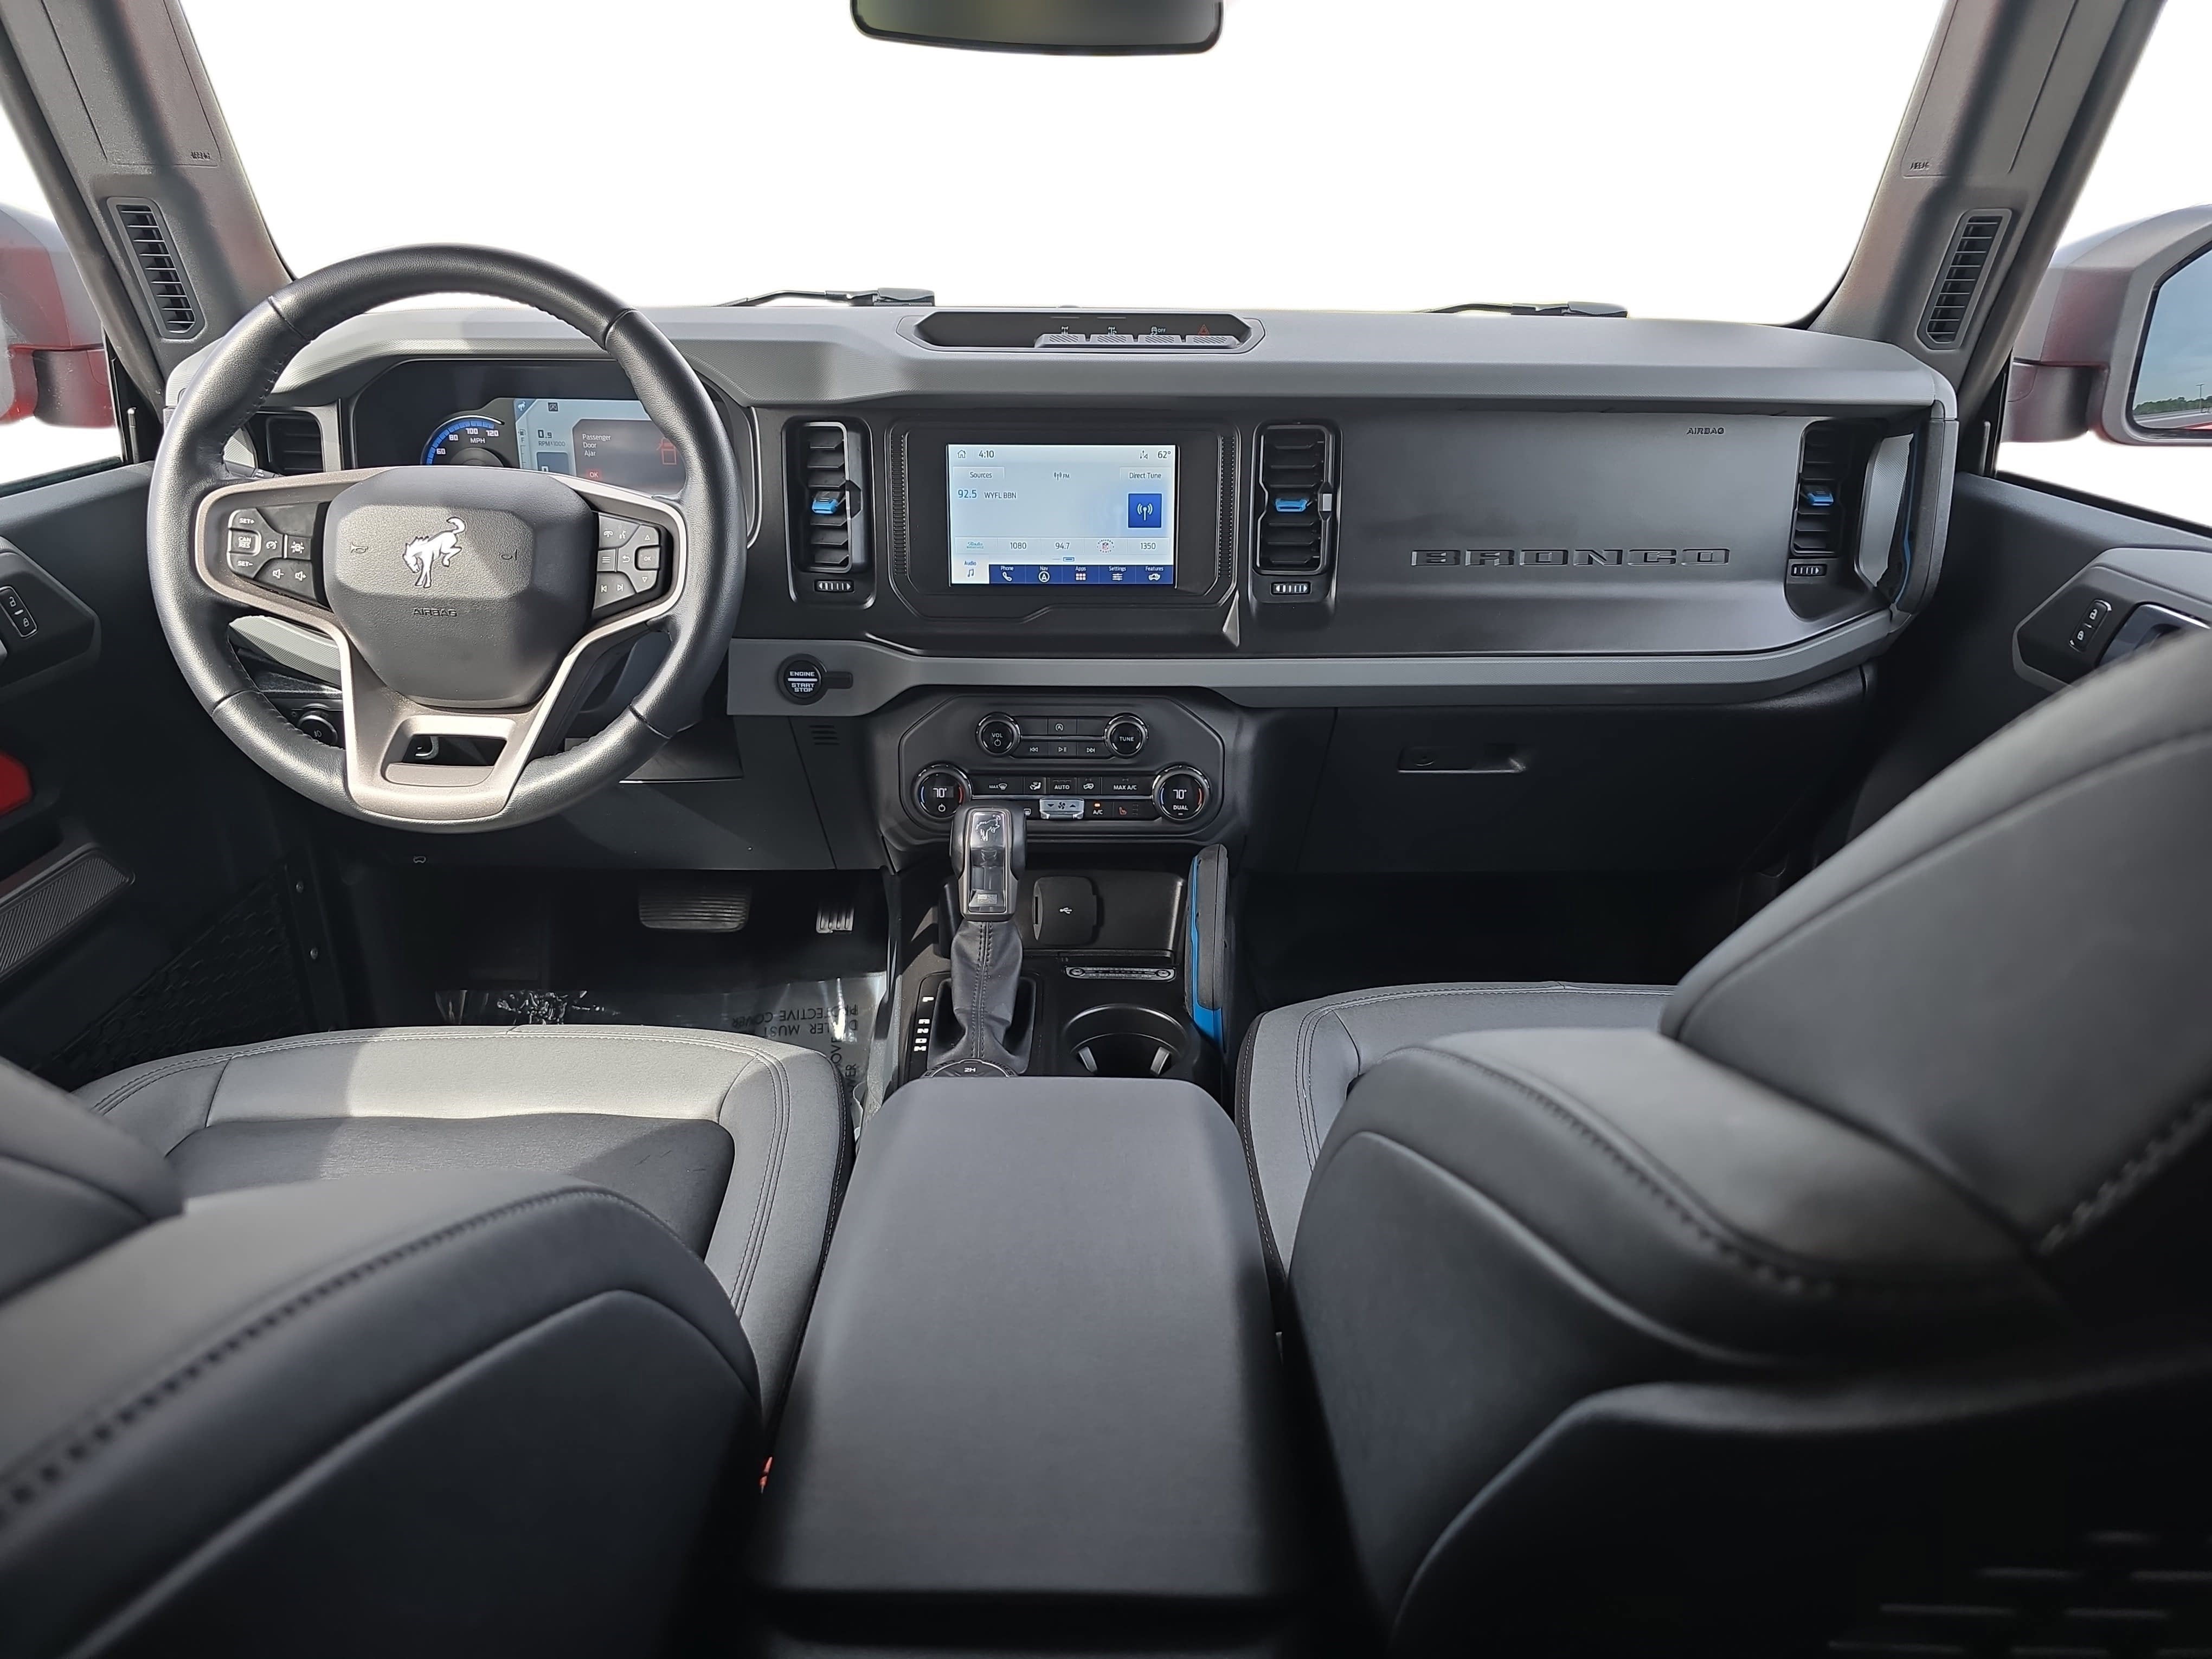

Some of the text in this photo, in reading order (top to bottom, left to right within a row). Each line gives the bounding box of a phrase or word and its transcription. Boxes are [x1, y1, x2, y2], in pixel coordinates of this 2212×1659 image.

[537, 429, 552, 439] 0.9
[979, 450, 994, 458] 4:10
[958, 490, 977, 498] 92.5
[1411, 548, 1731, 567] BRONCO
[413, 608, 457, 617] AIRBAG
[732, 1011, 773, 1028] COVER
[763, 1019, 859, 1038] DLER MUST
